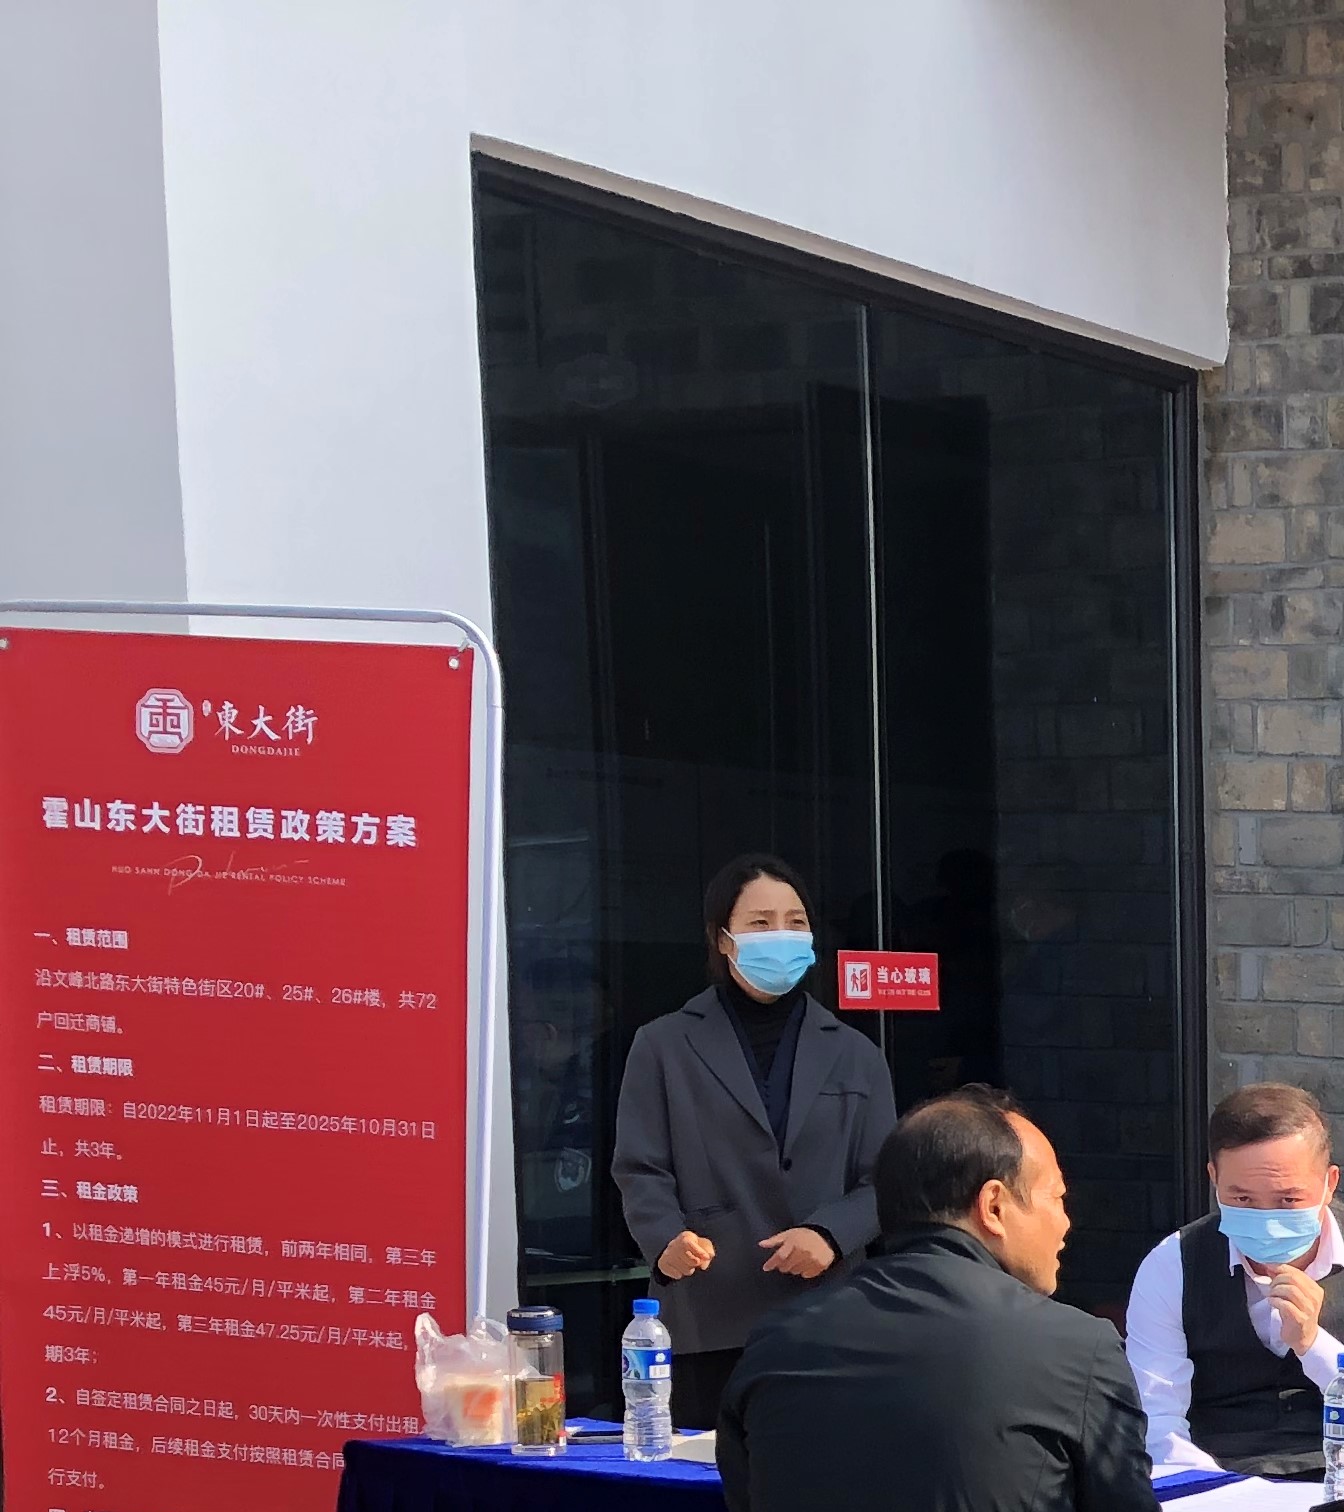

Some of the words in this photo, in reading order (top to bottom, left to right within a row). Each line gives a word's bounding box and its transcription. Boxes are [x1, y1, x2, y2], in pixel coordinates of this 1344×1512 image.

[214, 701, 318, 744] 東大街
[232, 745, 299, 756] DONGDAJIE
[43, 797, 416, 847] 霍山东大街租赁政策方案
[34, 928, 128, 949] 一、租赁范围
[877, 966, 931, 984] 当心玻璃
[38, 1055, 133, 1076] 二、租赁期限
[41, 1138, 122, 1160] 止，共3年。
[41, 1180, 138, 1202] 三、租金政策
[45, 1387, 425, 1435] 2、自签定租赁合同之日起，30天内一次性支付出租
[48, 1468, 104, 1489] 行支付。
